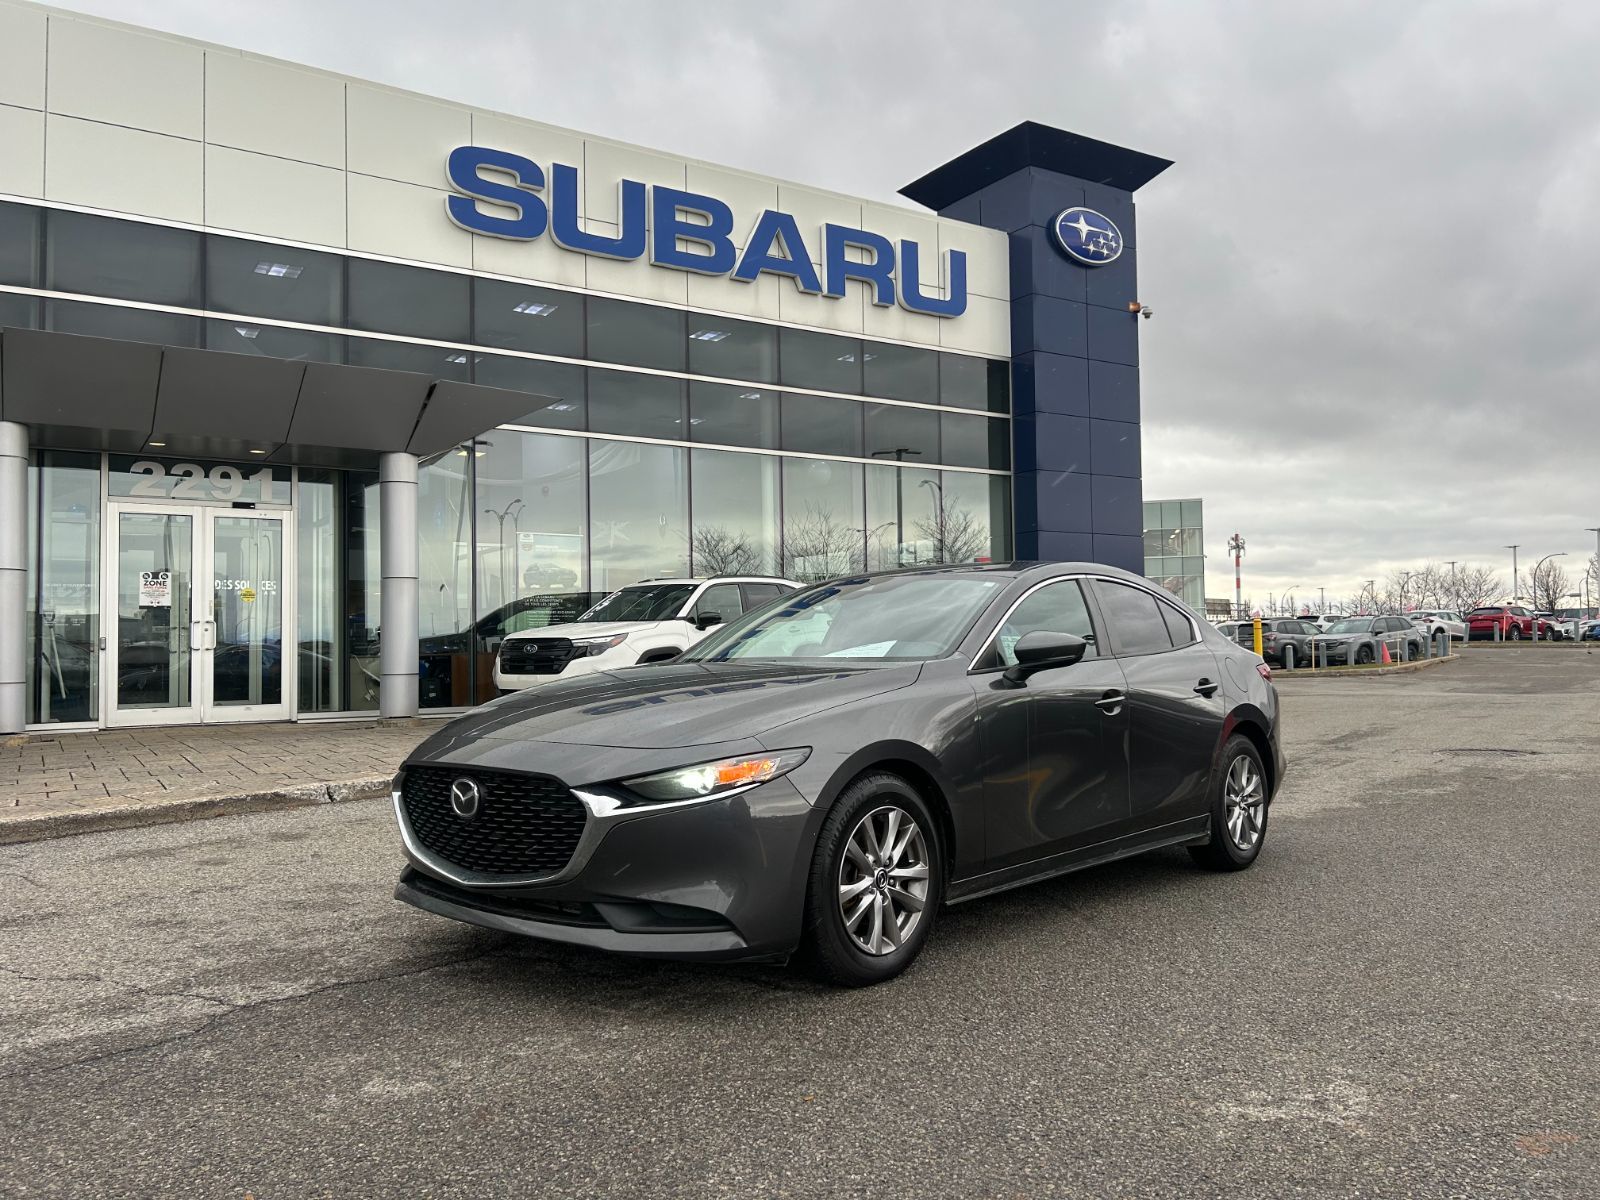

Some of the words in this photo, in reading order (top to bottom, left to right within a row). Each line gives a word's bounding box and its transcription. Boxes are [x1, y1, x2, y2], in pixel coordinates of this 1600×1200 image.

[445, 145, 968, 318] SUBARU
[129, 461, 273, 502] 2291
[215, 580, 233, 590] DES
